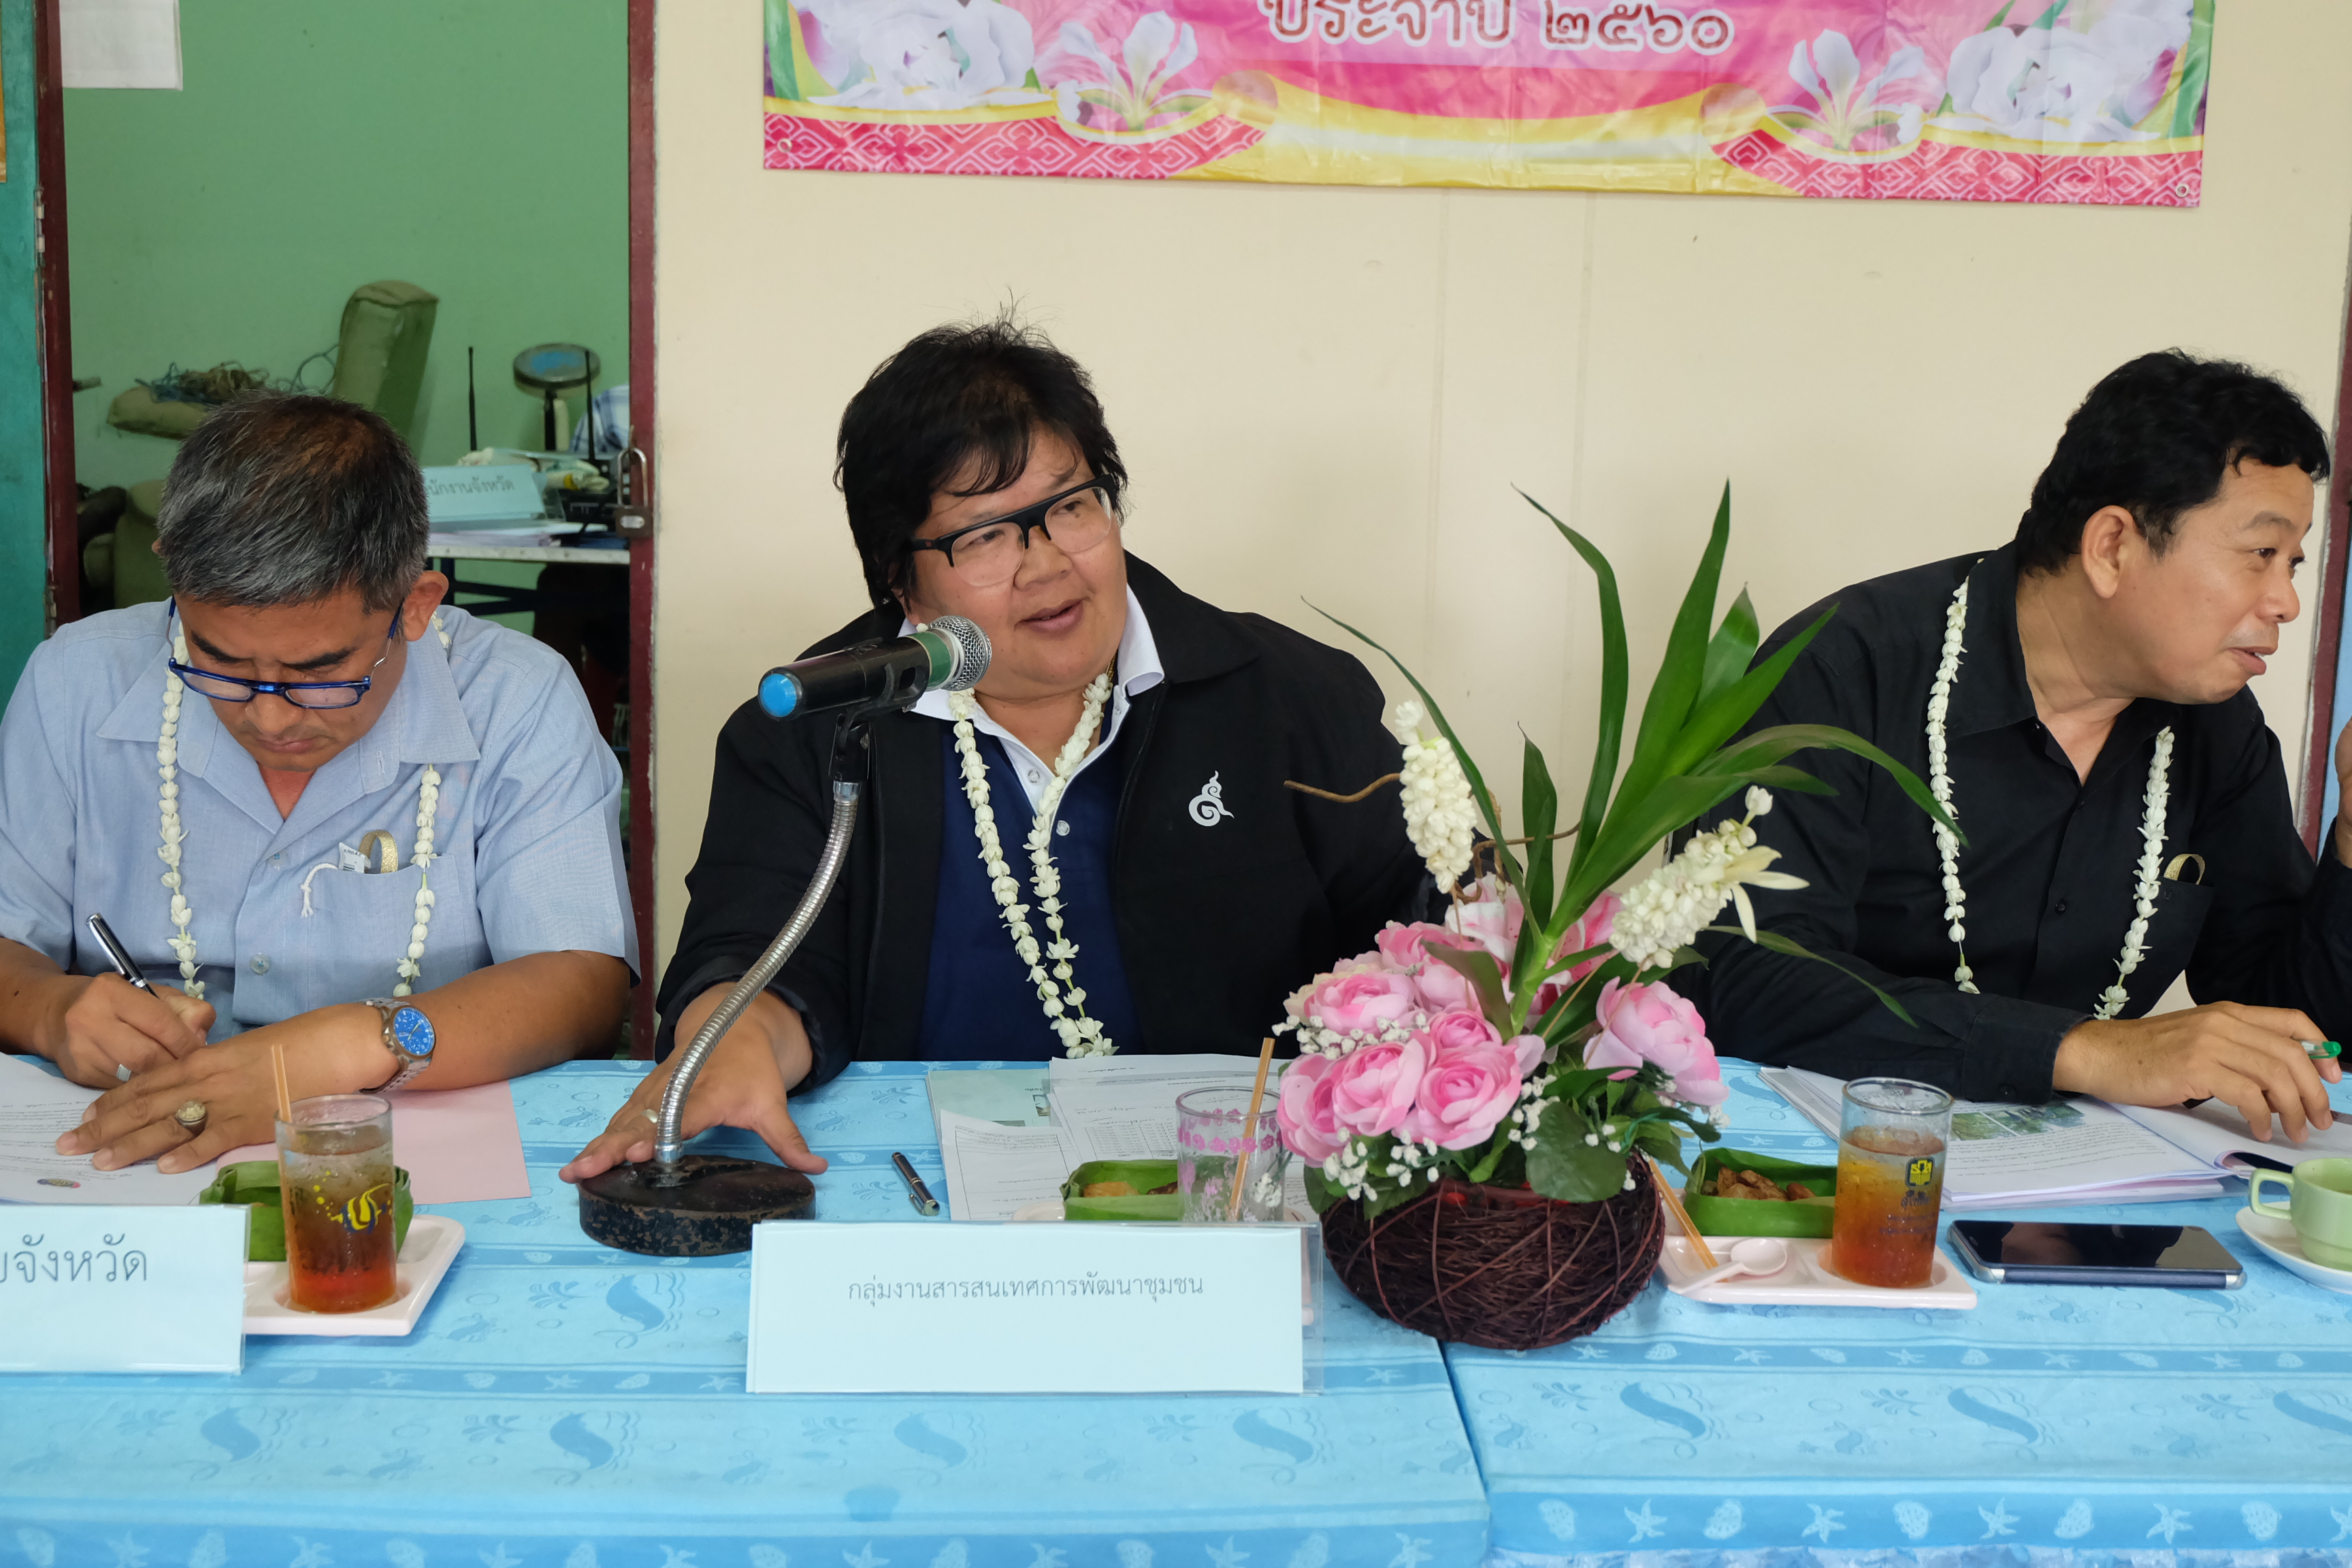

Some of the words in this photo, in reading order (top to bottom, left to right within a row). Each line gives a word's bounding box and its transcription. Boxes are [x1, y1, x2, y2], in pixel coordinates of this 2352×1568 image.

[1543, 0, 1731, 50] ๒๕๖๐
[427, 474, 515, 495] นักงานจังหวัด
[848, 1271, 1204, 1308] กลุ่มงานสารสนเทศการพัฒนาชุมชน
